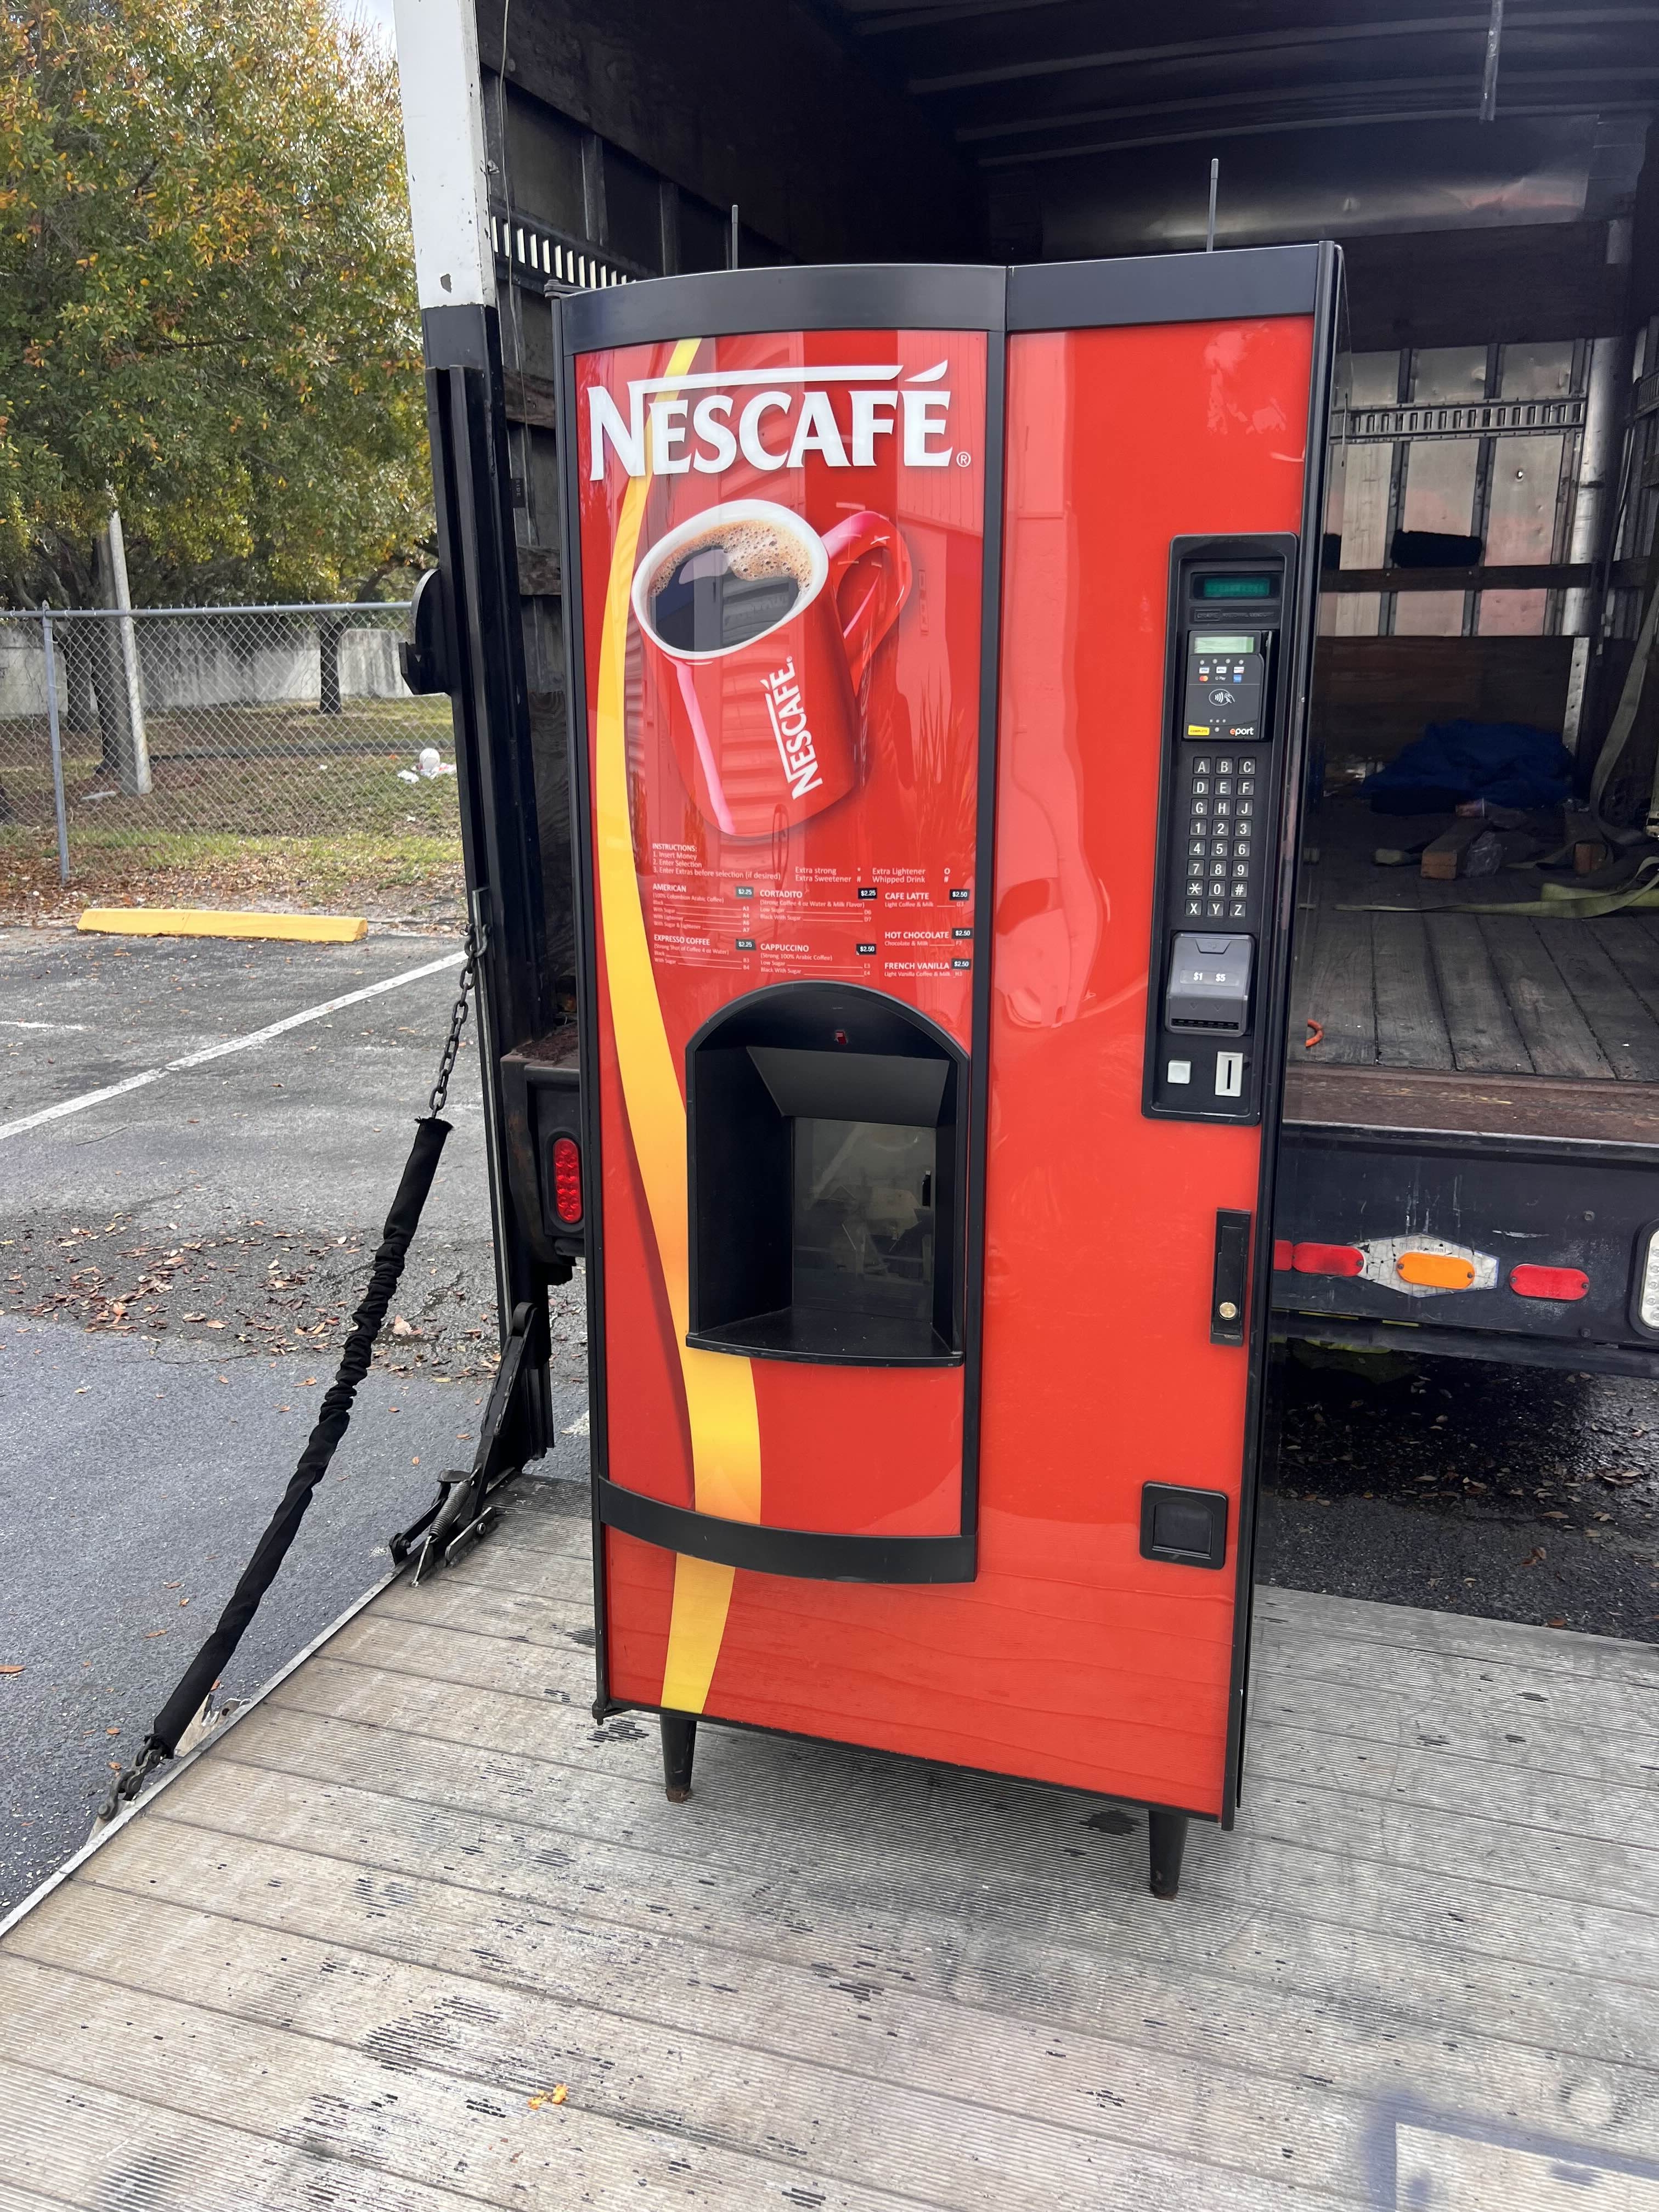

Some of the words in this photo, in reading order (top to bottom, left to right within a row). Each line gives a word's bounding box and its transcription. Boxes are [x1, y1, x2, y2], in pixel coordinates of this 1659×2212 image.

[1229, 727, 1254, 736] eport
[1198, 761, 1206, 772] A
[1221, 761, 1228, 772] B
[1243, 761, 1251, 773] C
[1197, 782, 1204, 793] D
[1220, 782, 1227, 793] E
[1242, 782, 1250, 793] F
[1195, 802, 1203, 814] G
[1218, 803, 1226, 814] H
[1241, 803, 1248, 814] J
[1195, 823, 1200, 833] 1
[1217, 823, 1224, 834] 2
[1240, 823, 1247, 834] 3
[652, 843, 697, 852] INSTRUCTIONS:
[1193, 843, 1200, 854] 4
[1216, 843, 1223, 854] 5
[1238, 844, 1246, 855] 6
[676, 852, 697, 861] Money
[675, 860, 702, 868] Selection
[815, 867, 837, 876] strong
[892, 867, 926, 876] Lightener
[1193, 864, 1200, 874] 7
[1215, 864, 1222, 875] 8
[1237, 865, 1244, 876] 9
[754, 872, 781, 881] desired)
[815, 874, 851, 883] Sweetener
[872, 876, 905, 884] Whipped
[653, 883, 686, 892] AMERICAN
[1214, 884, 1221, 895] 0
[1235, 884, 1244, 895] #
[759, 890, 803, 898] CORTADITO
[1189, 903, 1198, 914] X
[1212, 904, 1220, 915] Y
[1234, 905, 1242, 916] Z
[654, 934, 685, 944] EXPRESSO
[686, 937, 710, 946] COFFEE
[760, 943, 809, 952] CAPPUCCINO
[1193, 972, 1203, 981] $1
[1215, 973, 1226, 982] $5
